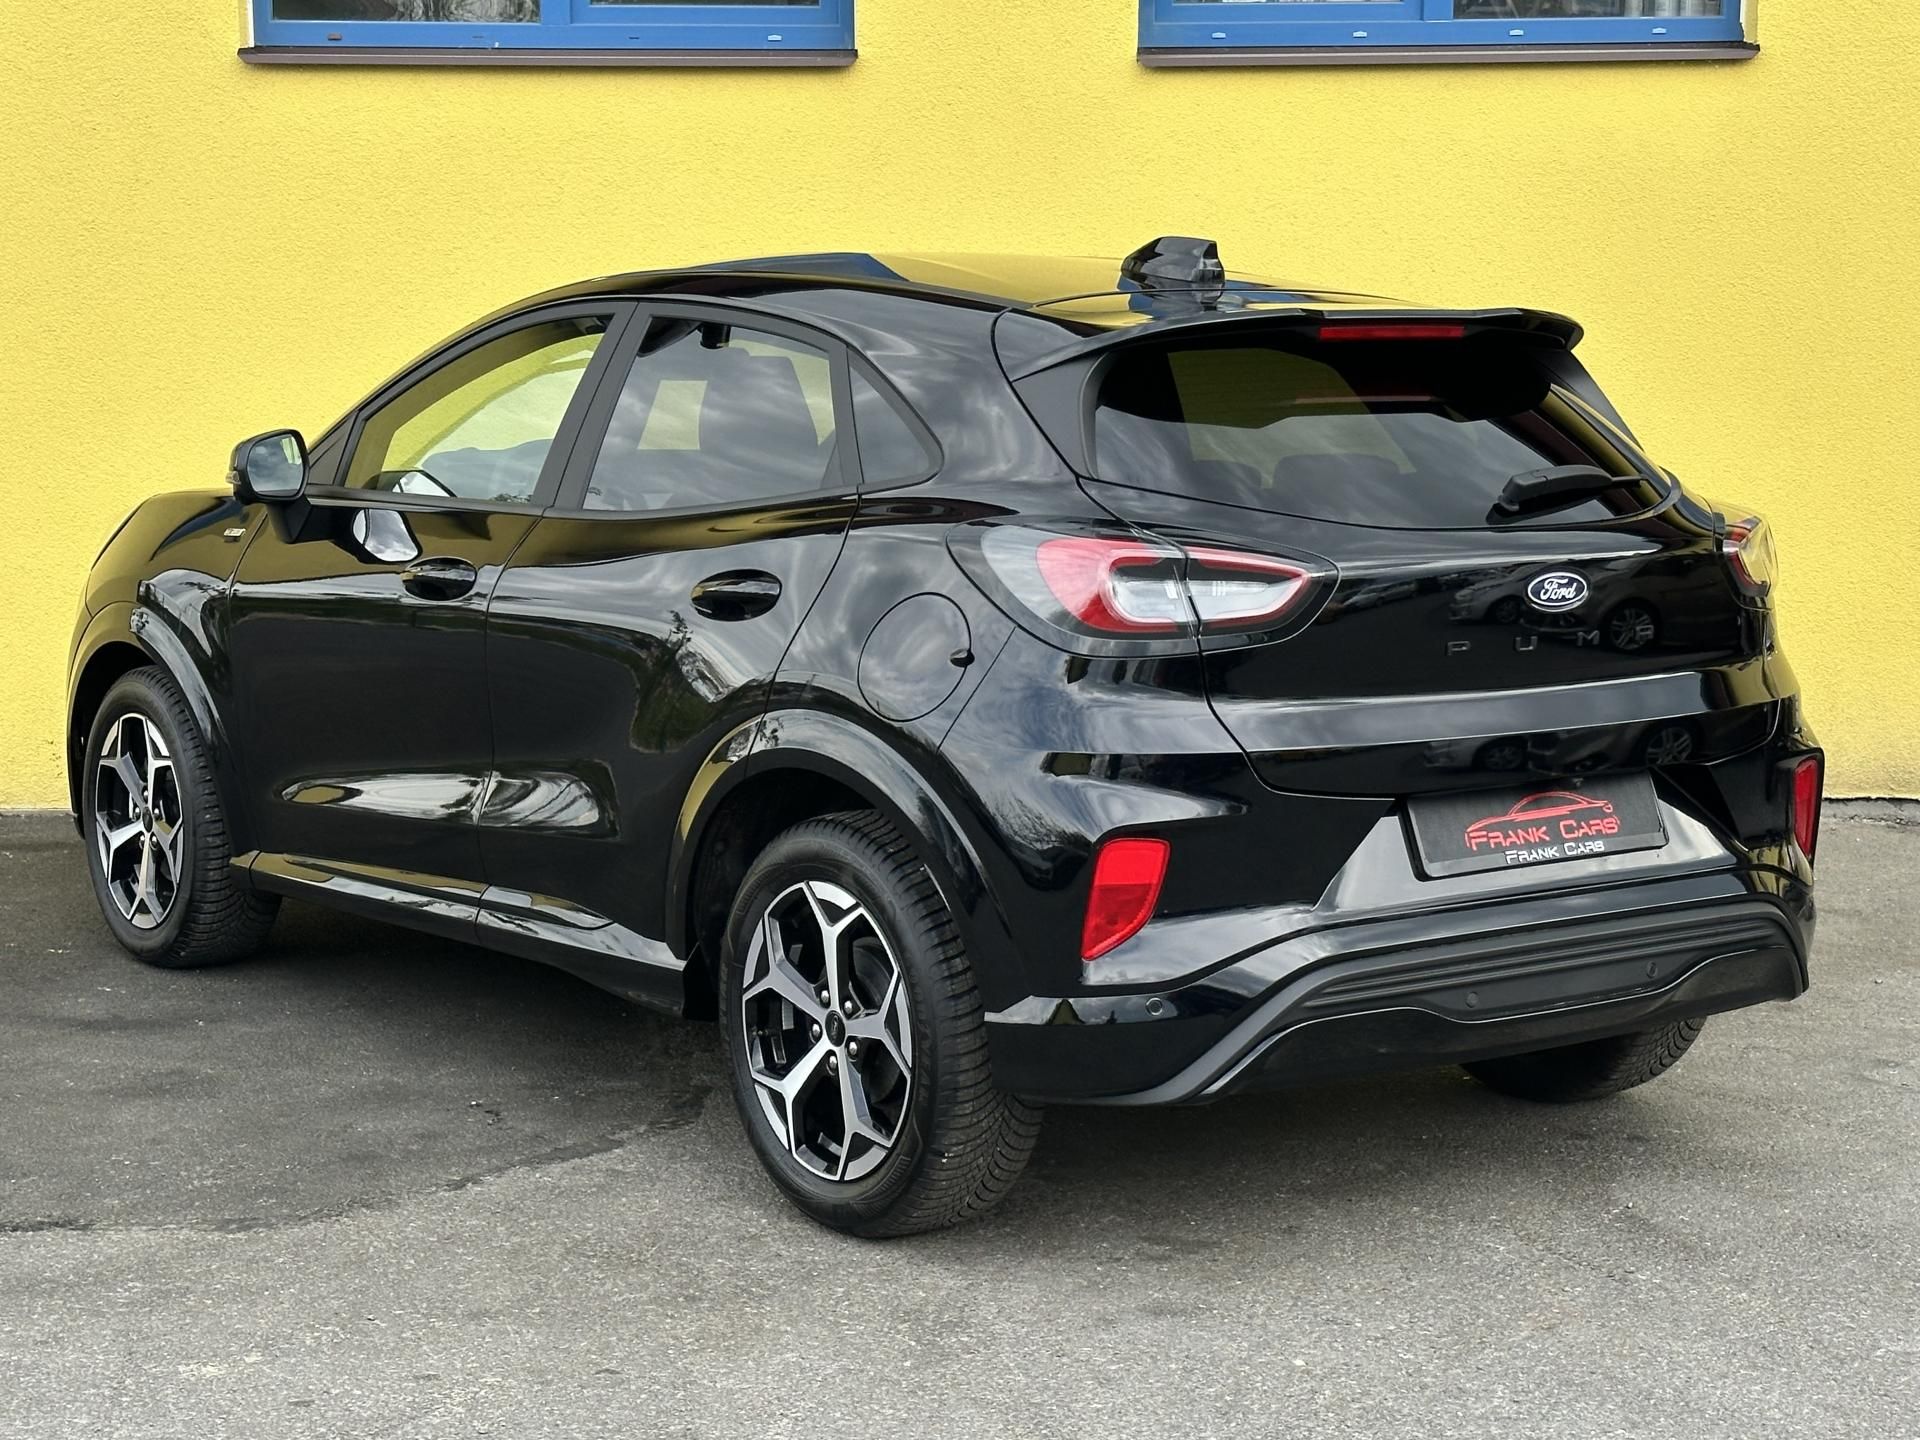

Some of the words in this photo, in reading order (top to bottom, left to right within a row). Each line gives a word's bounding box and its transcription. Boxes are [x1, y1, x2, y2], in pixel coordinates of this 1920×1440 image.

[1540, 579, 1577, 600] Ford
[1447, 625, 1654, 656] PUMA
[1468, 826, 1549, 851] FRANK
[1560, 819, 1619, 839] CARS
[1505, 846, 1560, 864] FRANK
[1564, 840, 1605, 856] CARS
